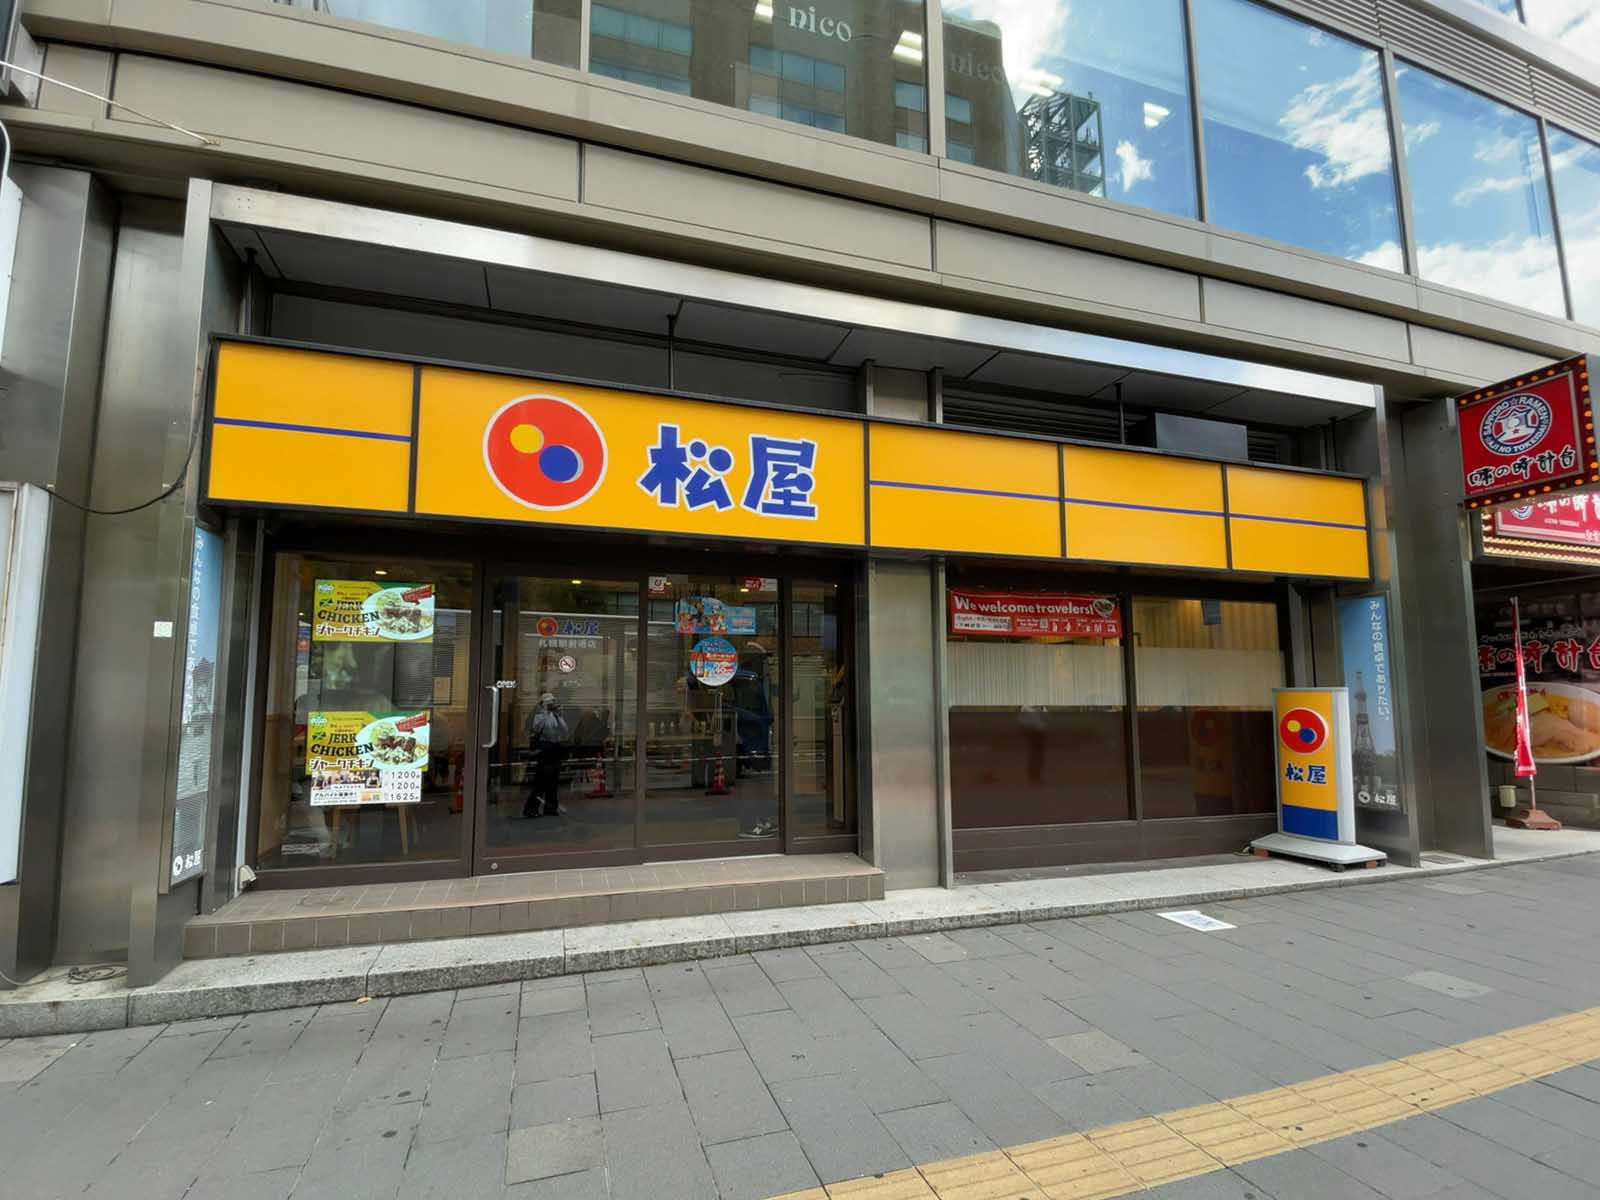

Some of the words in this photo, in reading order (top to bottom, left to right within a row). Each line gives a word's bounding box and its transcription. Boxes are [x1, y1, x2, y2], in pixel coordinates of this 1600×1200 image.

[788, 4, 853, 43] nico
[1483, 400, 1510, 436] SAPPORO
[1518, 395, 1549, 420] RAMEN
[1498, 445, 1513, 454] NO
[636, 422, 819, 521] 松屋
[1467, 445, 1577, 487] 味の時計台
[335, 600, 364, 611] JERK
[953, 595, 977, 611] We
[978, 600, 1035, 614] welcome
[1035, 601, 1095, 616] travelers!
[317, 609, 381, 623] CHICKEN
[316, 624, 382, 637] ジャークチキン
[328, 733, 357, 745] JERK
[310, 743, 375, 757] CHICKEN
[310, 758, 376, 771] ジャークチキン
[1284, 763, 1327, 785] 松屋
